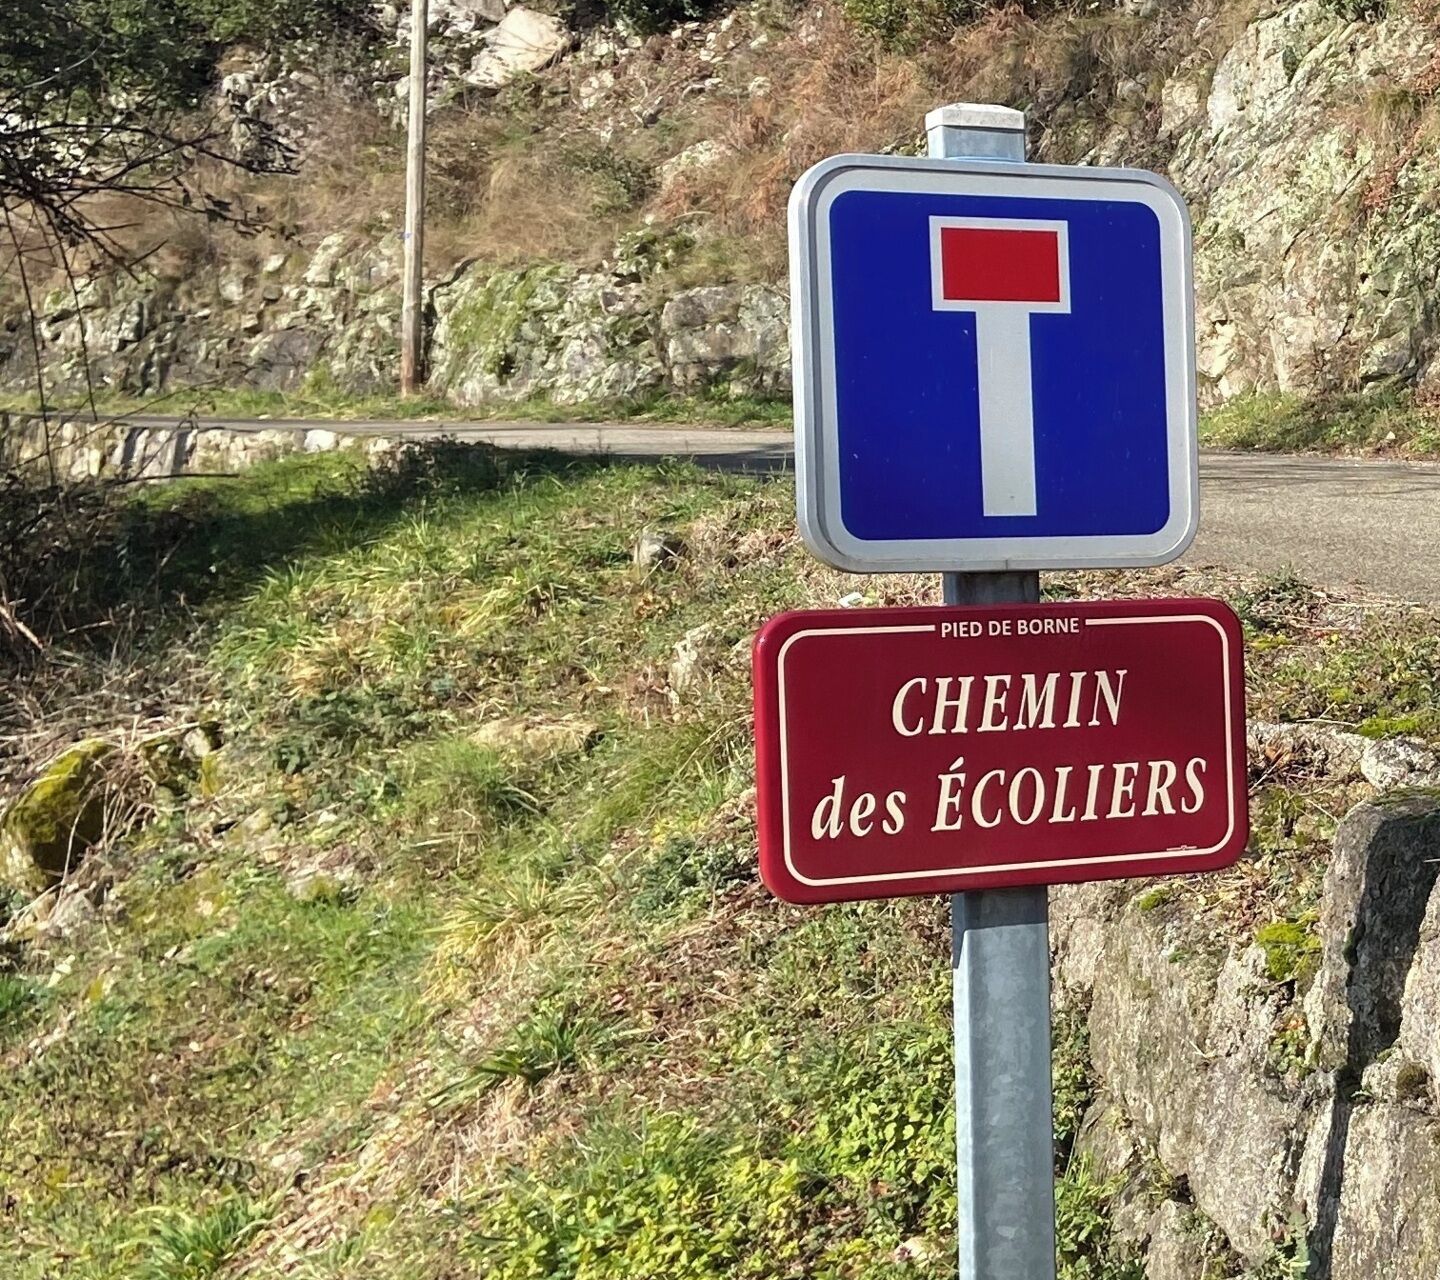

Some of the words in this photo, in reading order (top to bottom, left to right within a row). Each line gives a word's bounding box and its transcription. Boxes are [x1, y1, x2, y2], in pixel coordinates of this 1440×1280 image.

[941, 621, 983, 638] PIED
[988, 620, 1012, 636] DE
[1017, 618, 1080, 635] BORNE
[892, 669, 1128, 737] CHEMIN
[811, 775, 907, 841] des
[930, 756, 1208, 832] ÉCOLIERS
